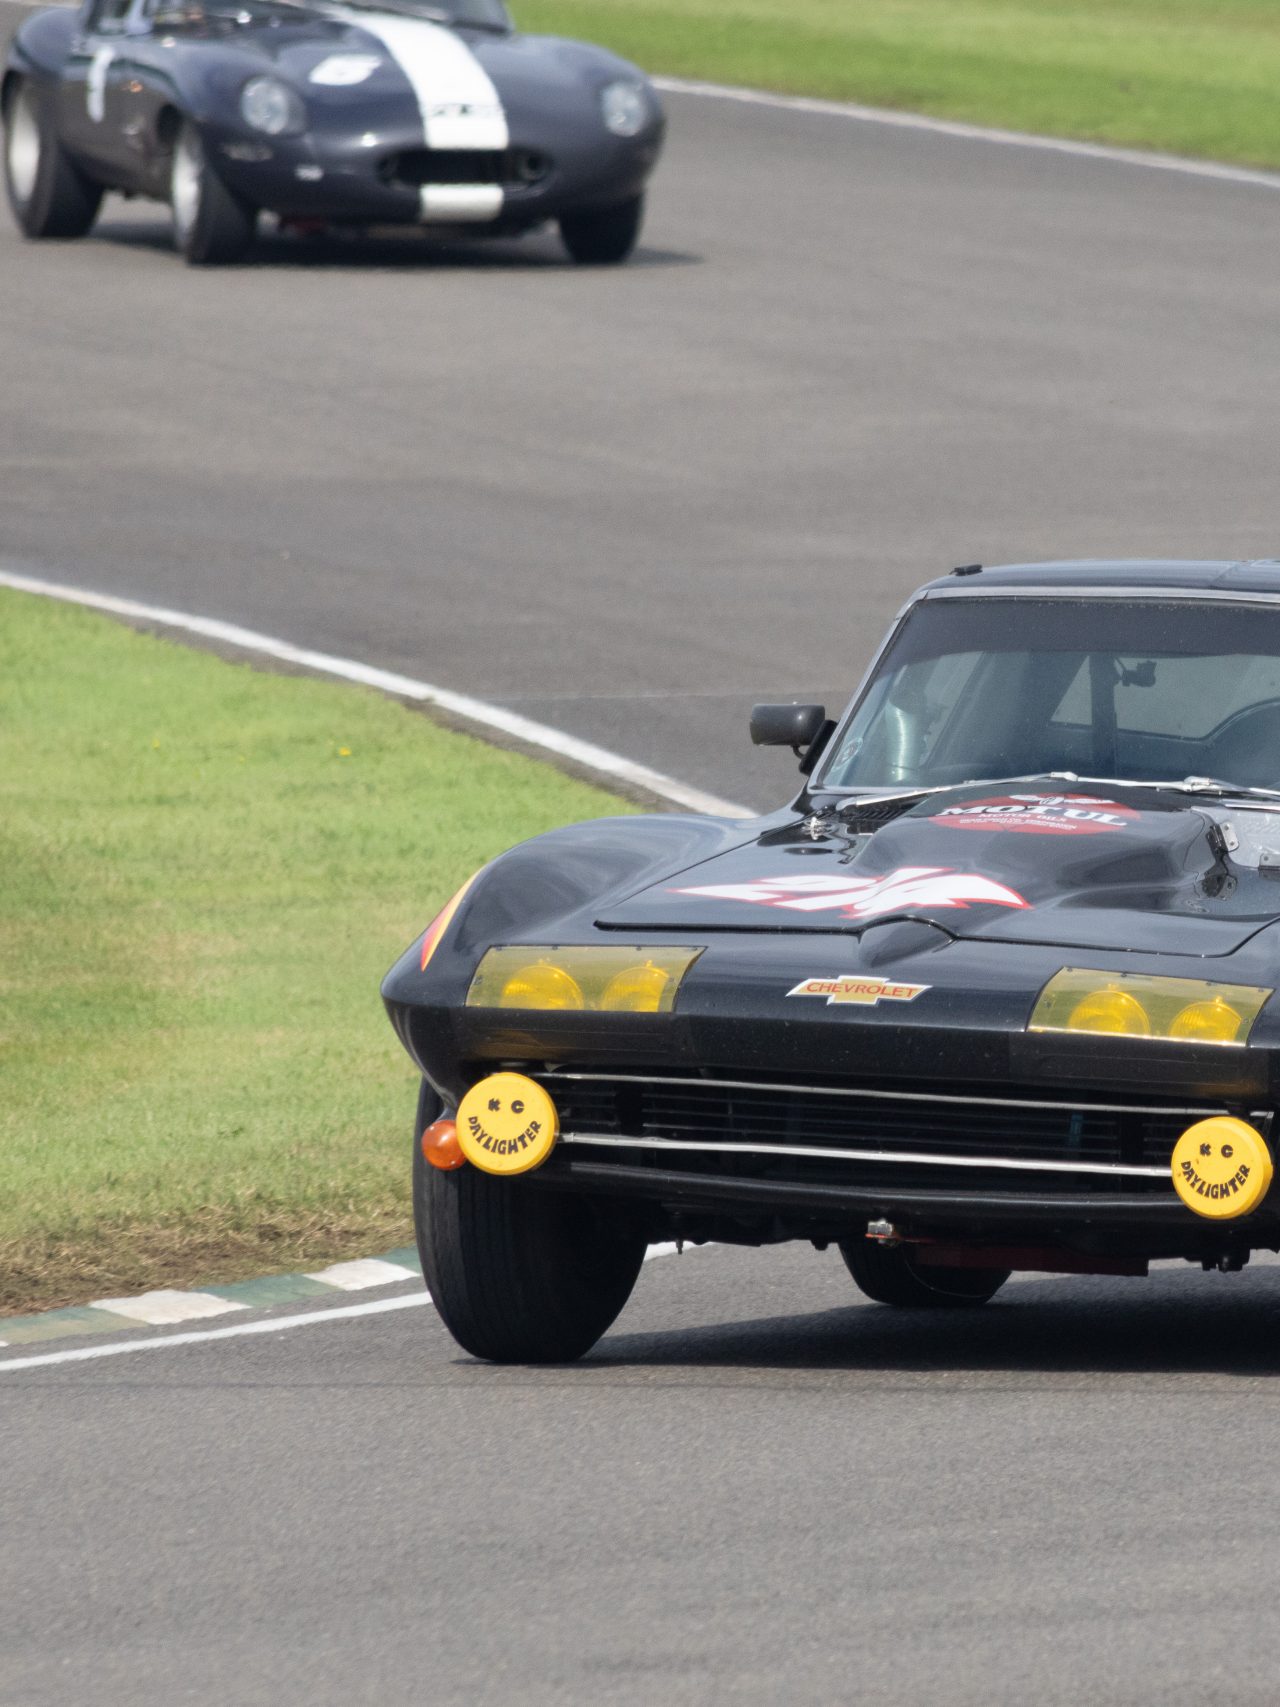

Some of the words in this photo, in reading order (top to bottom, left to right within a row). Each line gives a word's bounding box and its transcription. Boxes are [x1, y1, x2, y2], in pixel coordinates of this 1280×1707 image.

[936, 805, 1128, 826] MOTUL
[805, 980, 918, 999] CHEVROLET
[468, 1116, 543, 1155] DAYLIGHTER
[1181, 1160, 1251, 1199] DAYLIGHTER
